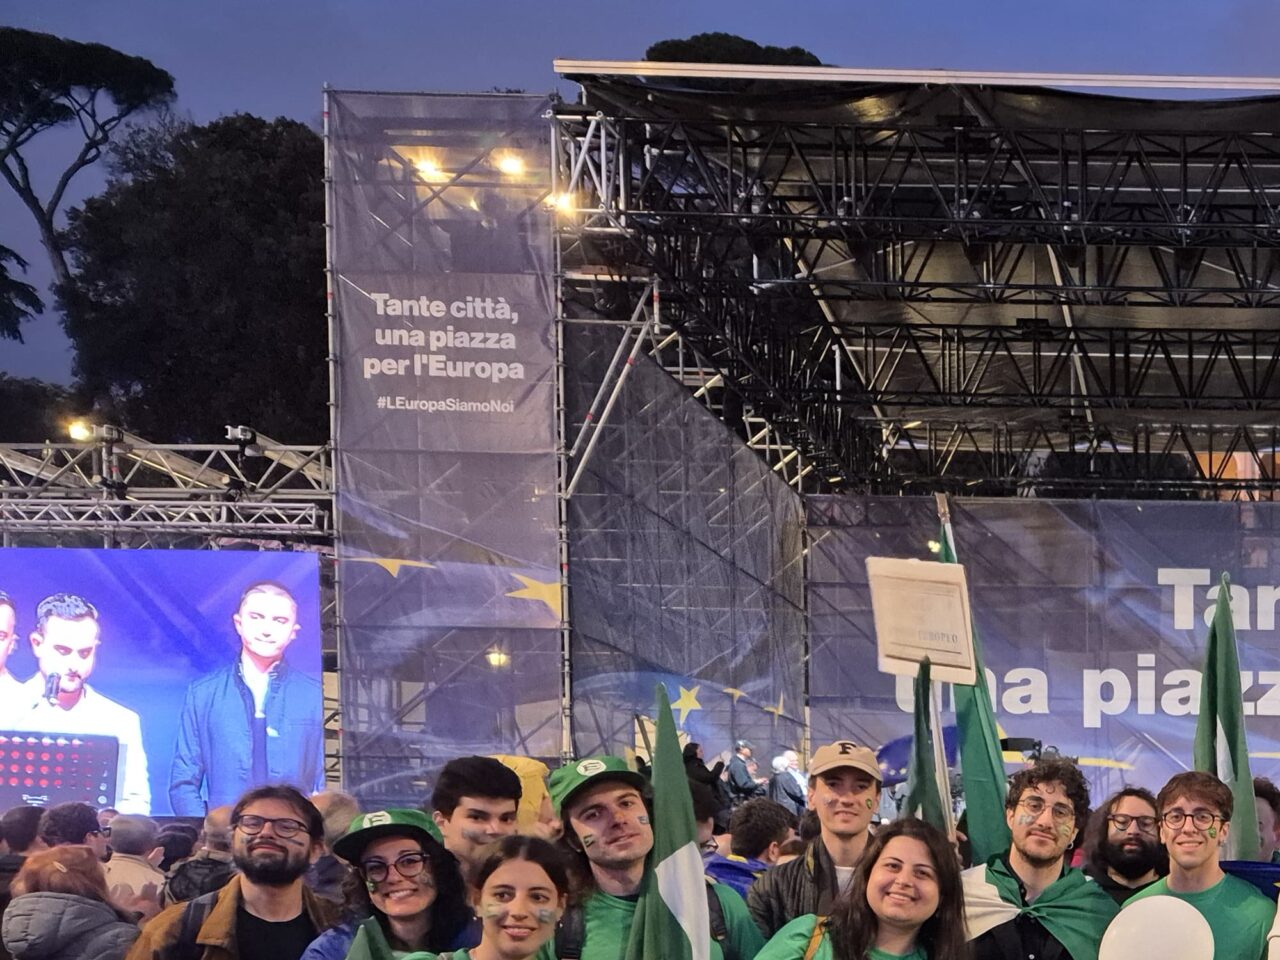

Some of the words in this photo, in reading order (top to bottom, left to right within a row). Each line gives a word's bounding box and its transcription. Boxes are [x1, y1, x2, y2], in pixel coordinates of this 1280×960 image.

[370, 293, 446, 317] Tante
[450, 296, 519, 324] città,
[375, 328, 425, 347] una
[429, 326, 516, 351] piazza
[363, 357, 410, 379] per
[413, 354, 525, 383] l'Europa
[377, 396, 514, 413] #LEuropaSiamoNoi
[838, 742, 856, 755] F
